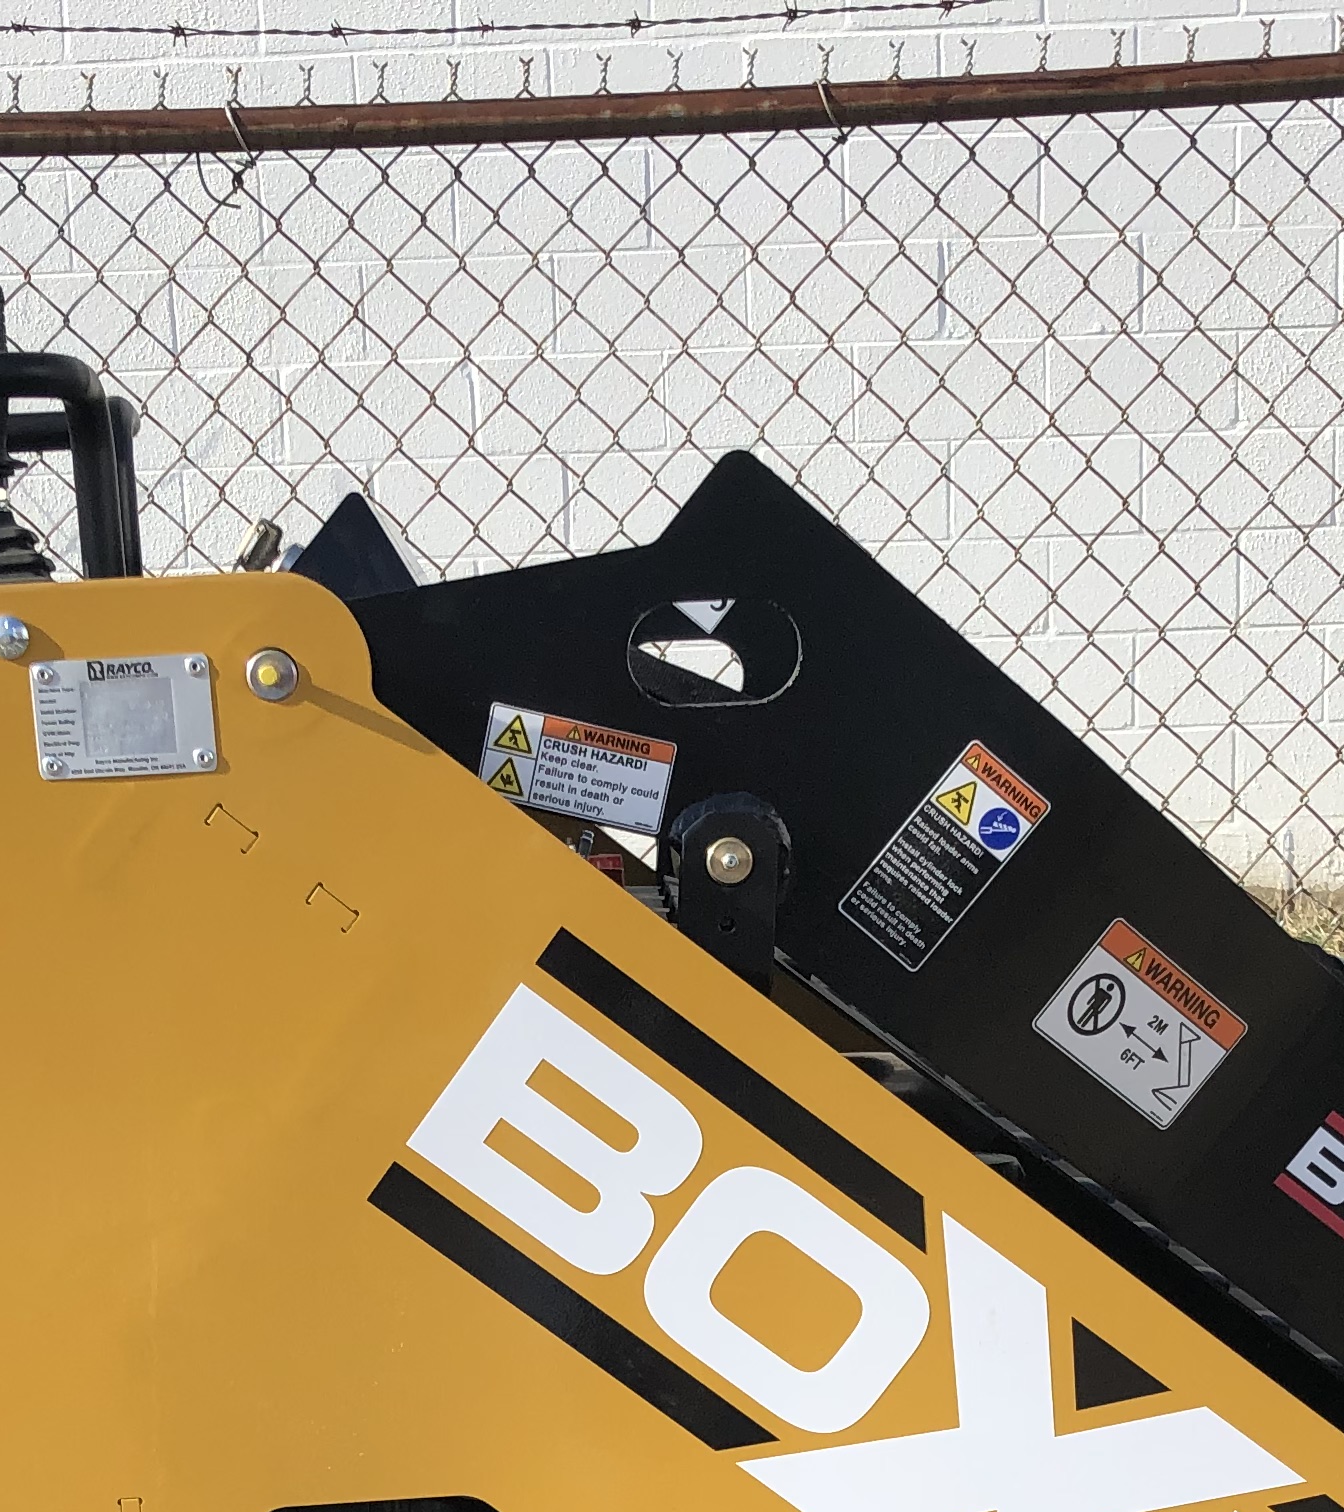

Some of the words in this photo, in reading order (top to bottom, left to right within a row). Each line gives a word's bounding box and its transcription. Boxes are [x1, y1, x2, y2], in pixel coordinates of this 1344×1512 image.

[107, 662, 152, 674] RAYCO
[543, 739, 587, 758] CRUSH
[591, 747, 648, 772] HAZARD!
[584, 728, 651, 755] WARNING
[541, 752, 567, 767] Keep
[570, 758, 599, 773] clear.
[534, 778, 565, 793] result
[568, 785, 577, 795] in
[580, 787, 610, 803] death
[613, 797, 624, 806] or
[538, 764, 574, 781] Failure
[578, 773, 588, 784] to
[591, 778, 629, 794] comply
[630, 785, 659, 800] could
[981, 762, 1042, 820] WARNING
[533, 792, 570, 808] serious
[574, 800, 605, 816] injury.
[907, 824, 928, 843] could
[914, 815, 940, 840] Raised
[938, 837, 961, 859] loader
[959, 856, 980, 875] arms
[923, 804, 951, 830] CRUSH
[950, 826, 985, 859] HAZARD!
[884, 851, 929, 891] maintenance
[928, 889, 945, 904] that
[891, 844, 911, 864] when
[909, 860, 949, 897] performing
[898, 836, 920, 858] Install
[919, 852, 948, 883] cylinder
[946, 877, 963, 896] lock
[862, 880, 888, 905] Failure
[888, 901, 896, 912] to
[894, 909, 922, 935] comply
[879, 859, 909, 887] requires
[907, 883, 931, 905] raised
[929, 901, 954, 924] loader
[850, 897, 860, 906] or
[859, 903, 886, 929] serious
[856, 889, 878, 909] could
[876, 904, 899, 928] result
[897, 923, 906, 934] in
[905, 929, 926, 950] death
[1145, 958, 1220, 1029] WARNING
[1146, 1014, 1169, 1036] 2M
[1120, 1048, 1145, 1070] 6FT
